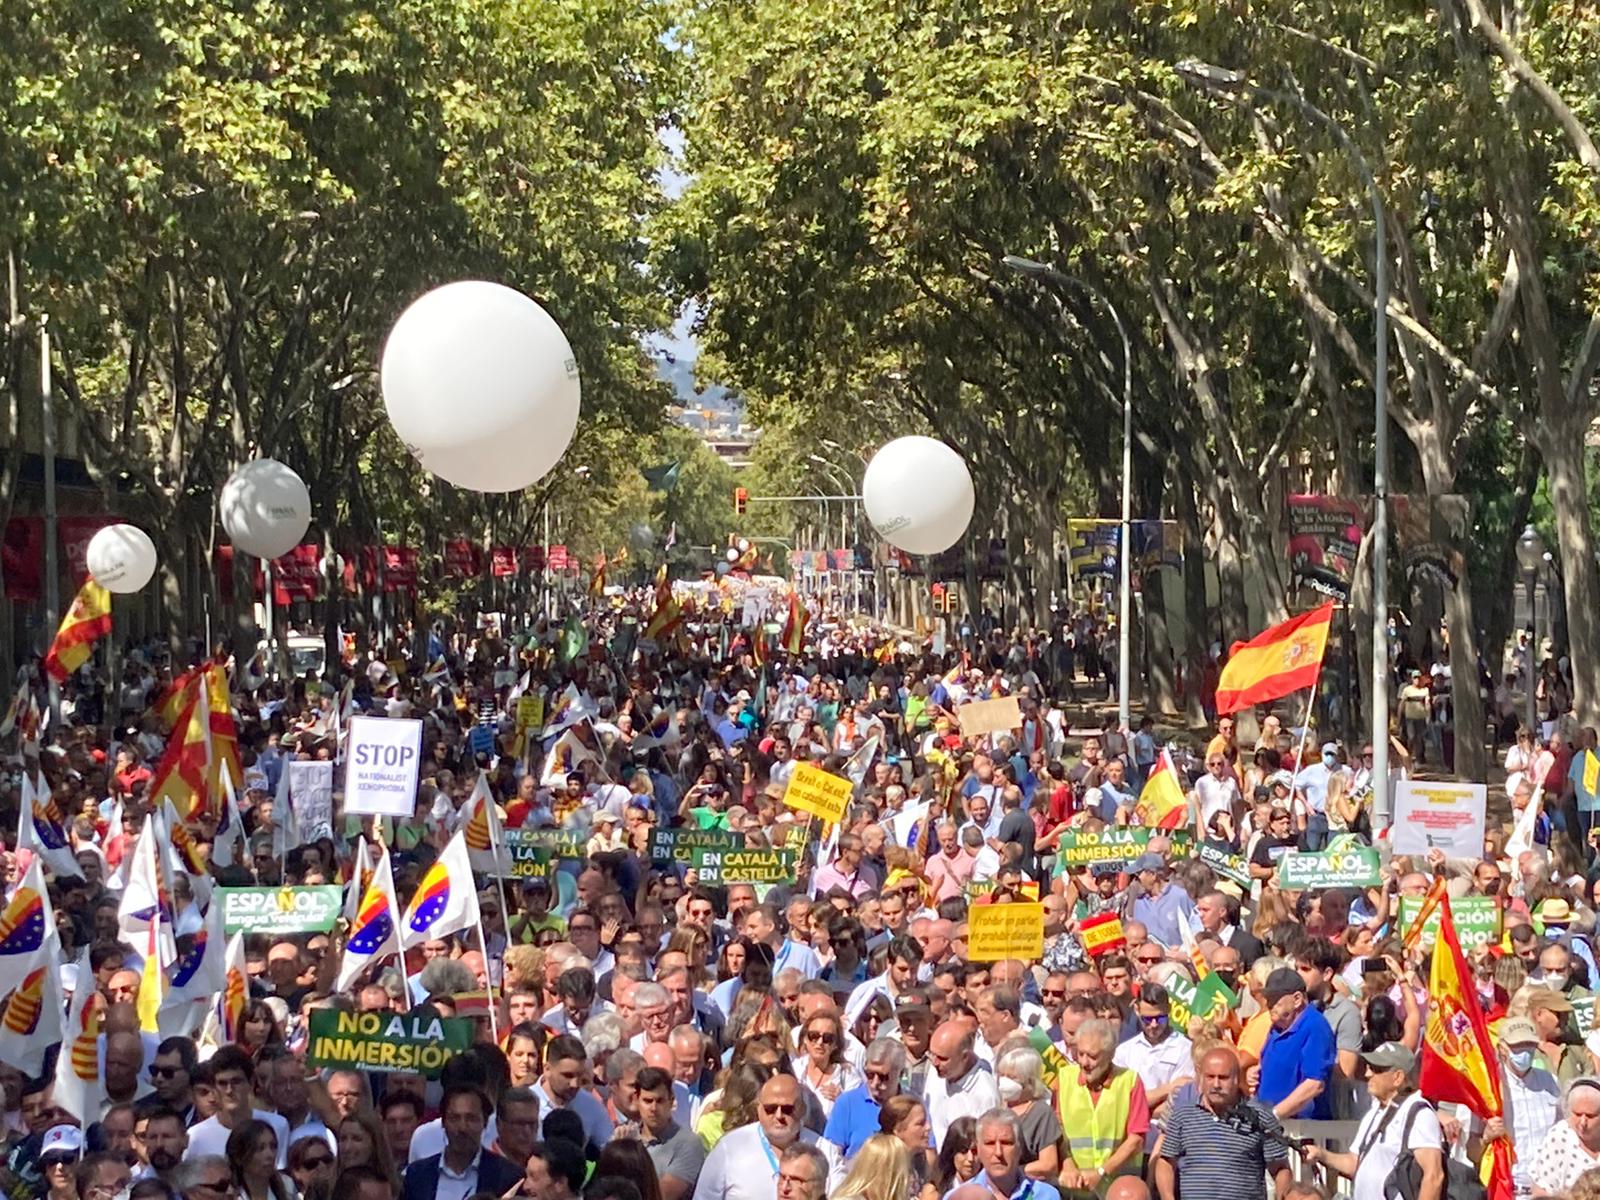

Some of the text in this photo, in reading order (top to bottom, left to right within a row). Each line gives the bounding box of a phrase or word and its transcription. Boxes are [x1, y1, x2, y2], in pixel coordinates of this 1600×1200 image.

[355, 743, 414, 767] STOP
[358, 772, 407, 782] NATIONALIST
[358, 783, 406, 792] XENOPHOBIA
[656, 832, 674, 844] EN
[677, 833, 729, 848] CATALÀ
[1075, 830, 1135, 845] NO A LA
[653, 847, 670, 859] EN
[702, 852, 786, 866] EN CATALÀ I
[1065, 842, 1146, 861] INMERSIÓN
[1201, 845, 1249, 873] ESPAÑO
[700, 865, 788, 881] EN CASTELLÀ
[1287, 870, 1371, 884] lengua vehicular
[225, 912, 268, 928] lengua
[1175, 980, 1198, 1006] LA
[338, 1011, 445, 1041] NO A LA
